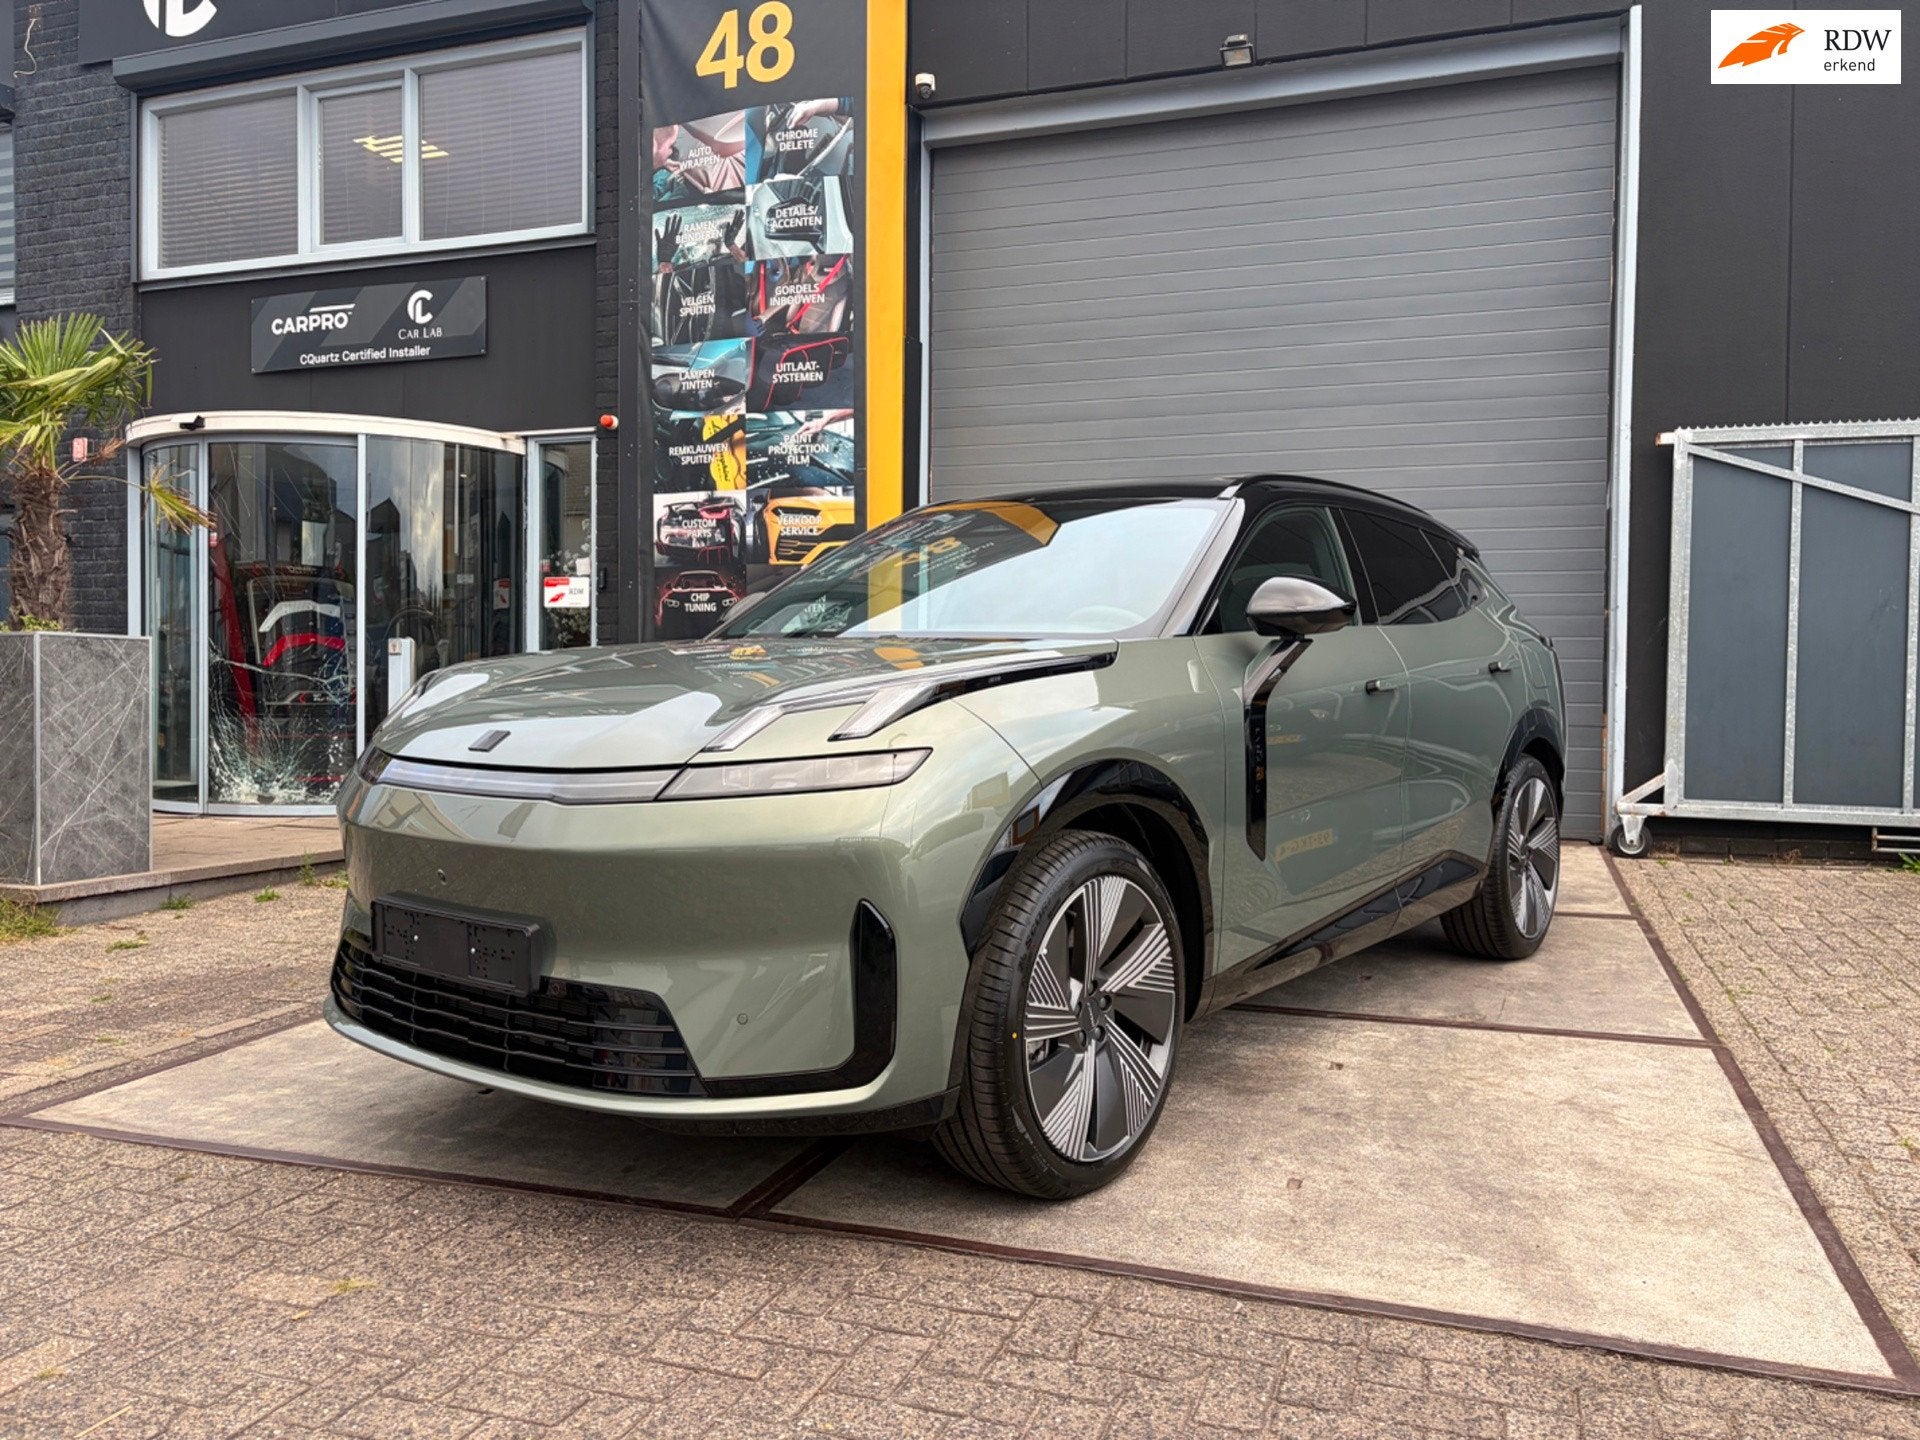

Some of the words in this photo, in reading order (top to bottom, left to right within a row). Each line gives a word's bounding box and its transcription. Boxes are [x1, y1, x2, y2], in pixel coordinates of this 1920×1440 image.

[695, 1, 796, 90] 48
[775, 128, 818, 142] CHROME
[779, 139, 814, 152] DELETE
[771, 215, 823, 229] ACCENTEN
[775, 283, 820, 296] GORDELS
[680, 293, 715, 306] VELGEN
[769, 294, 825, 307] INBOUWEN
[271, 312, 349, 335] CARPRO
[397, 328, 419, 340] CAR
[423, 326, 443, 339] LAB
[299, 350, 340, 365] CQuartz
[342, 347, 387, 362] Certified
[389, 345, 431, 358] Installer
[776, 361, 820, 373] UITLAAT-
[678, 369, 715, 382] LAMPEN
[772, 371, 824, 384] SYSTEMEN
[681, 379, 713, 391] TINTEN
[668, 443, 729, 456] REMKLAUWEN
[768, 443, 830, 455] PROTECTION
[681, 454, 715, 466] SPUITEN
[787, 454, 811, 465] FILM
[682, 518, 717, 528] CUSTOM
[780, 526, 819, 536] SERVICE
[690, 592, 711, 602] CHIP
[684, 601, 717, 613] TUNING
